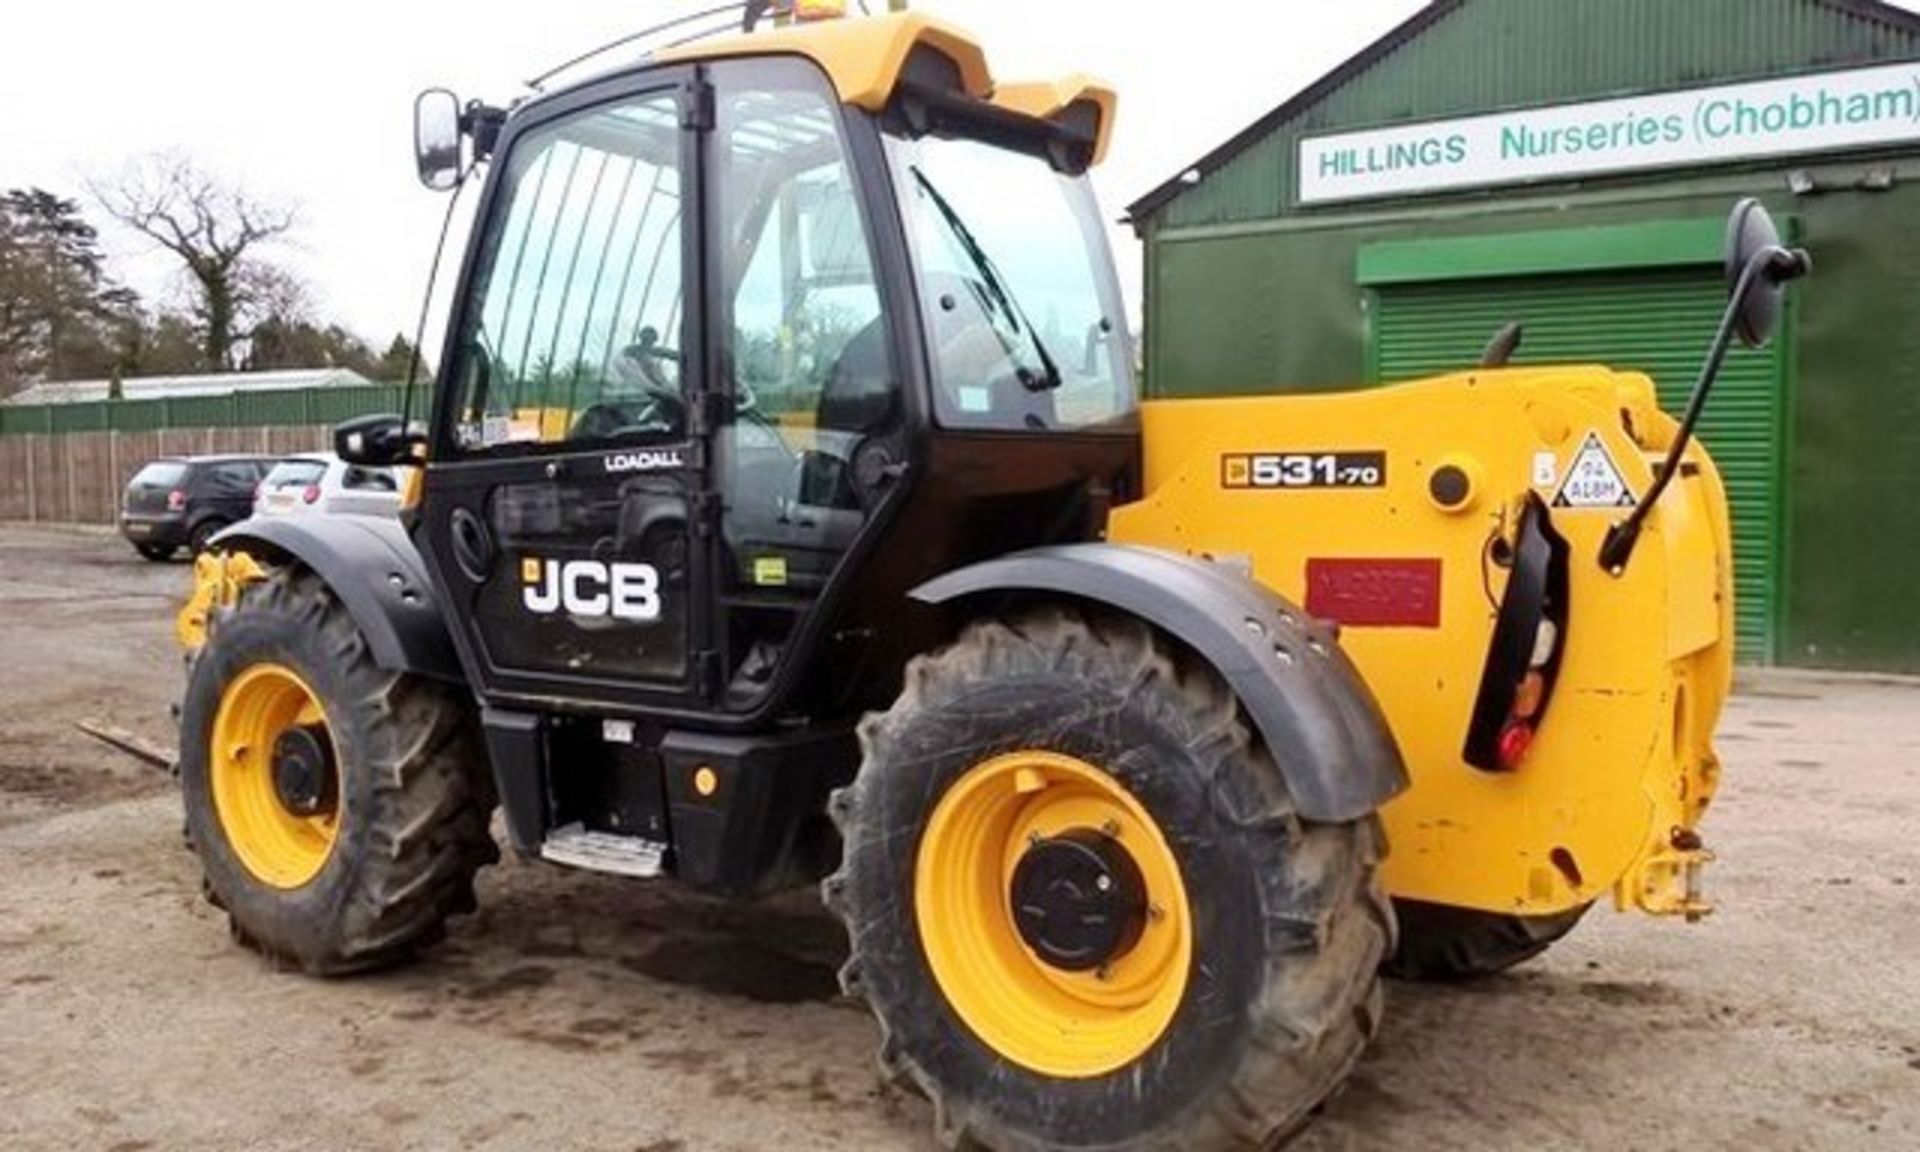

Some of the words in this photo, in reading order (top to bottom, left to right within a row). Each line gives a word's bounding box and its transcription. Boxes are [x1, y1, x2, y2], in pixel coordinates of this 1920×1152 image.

[1318, 135, 1467, 177] HILLINGS
[1500, 112, 1684, 160] Nurseries
[605, 452, 683, 472] LOADALL
[523, 559, 660, 619] JCB
